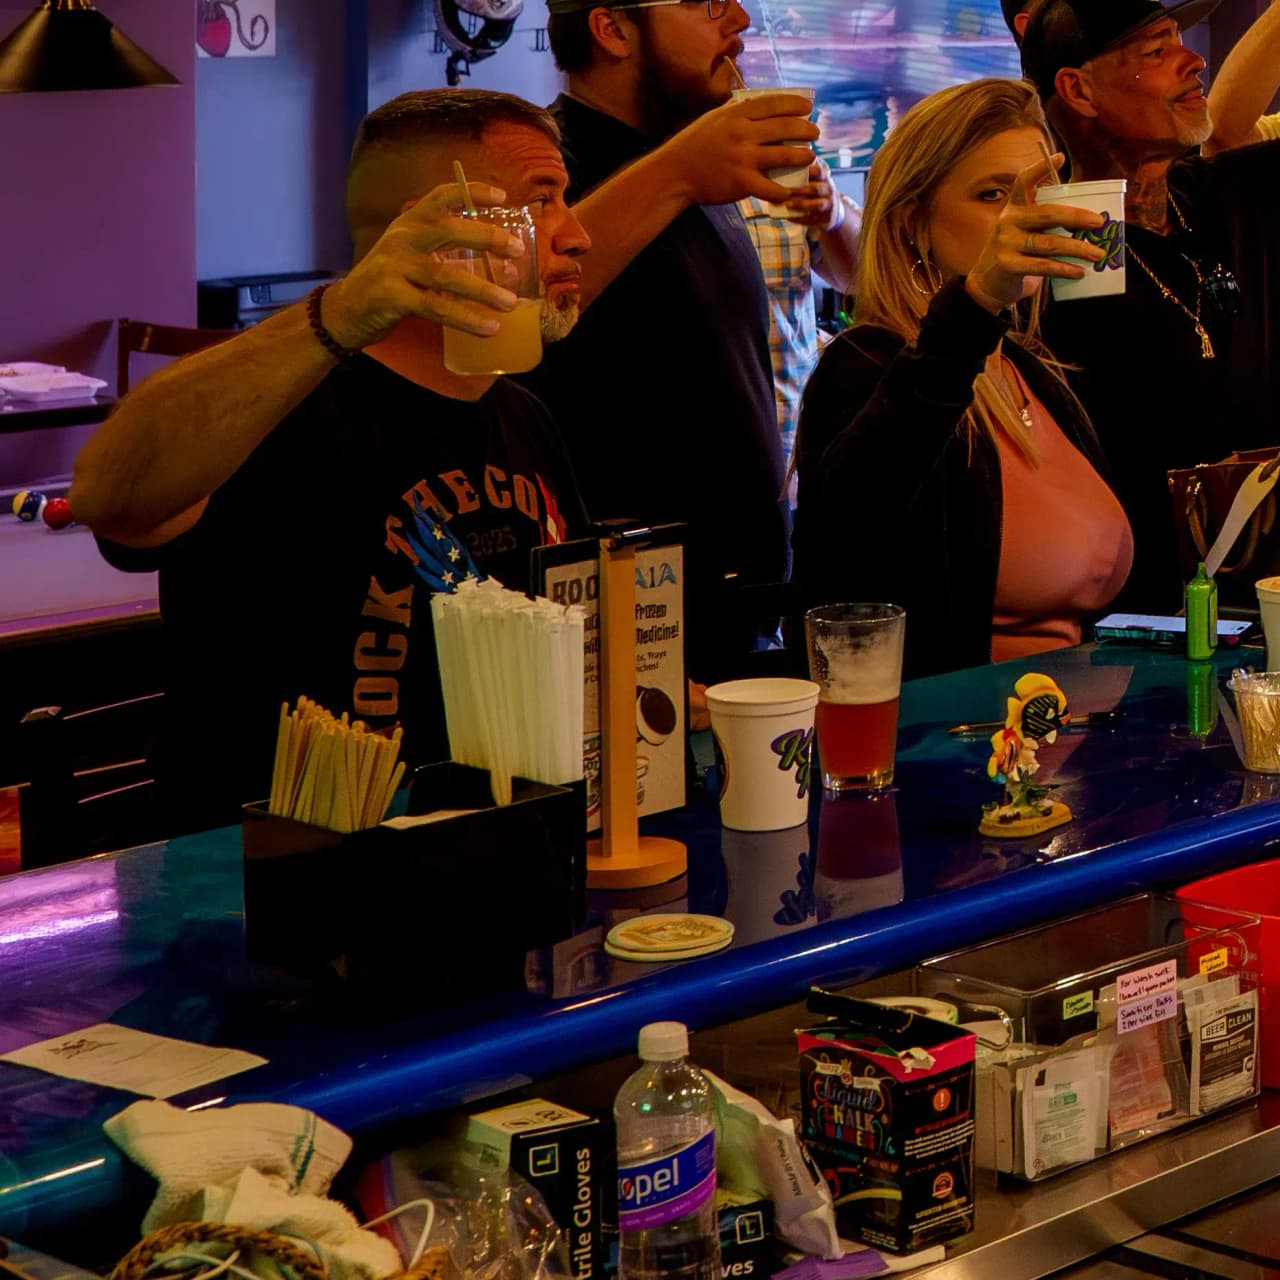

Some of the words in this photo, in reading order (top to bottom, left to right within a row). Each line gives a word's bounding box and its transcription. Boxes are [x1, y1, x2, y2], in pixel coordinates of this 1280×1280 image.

[351, 574, 415, 720] OCK
[1206, 1021, 1225, 1036] BEER
[1228, 1011, 1253, 1028] CLEAN
[573, 1147, 592, 1229] Gloves
[573, 1231, 592, 1280] trile
[720, 1259, 755, 1279] ves
